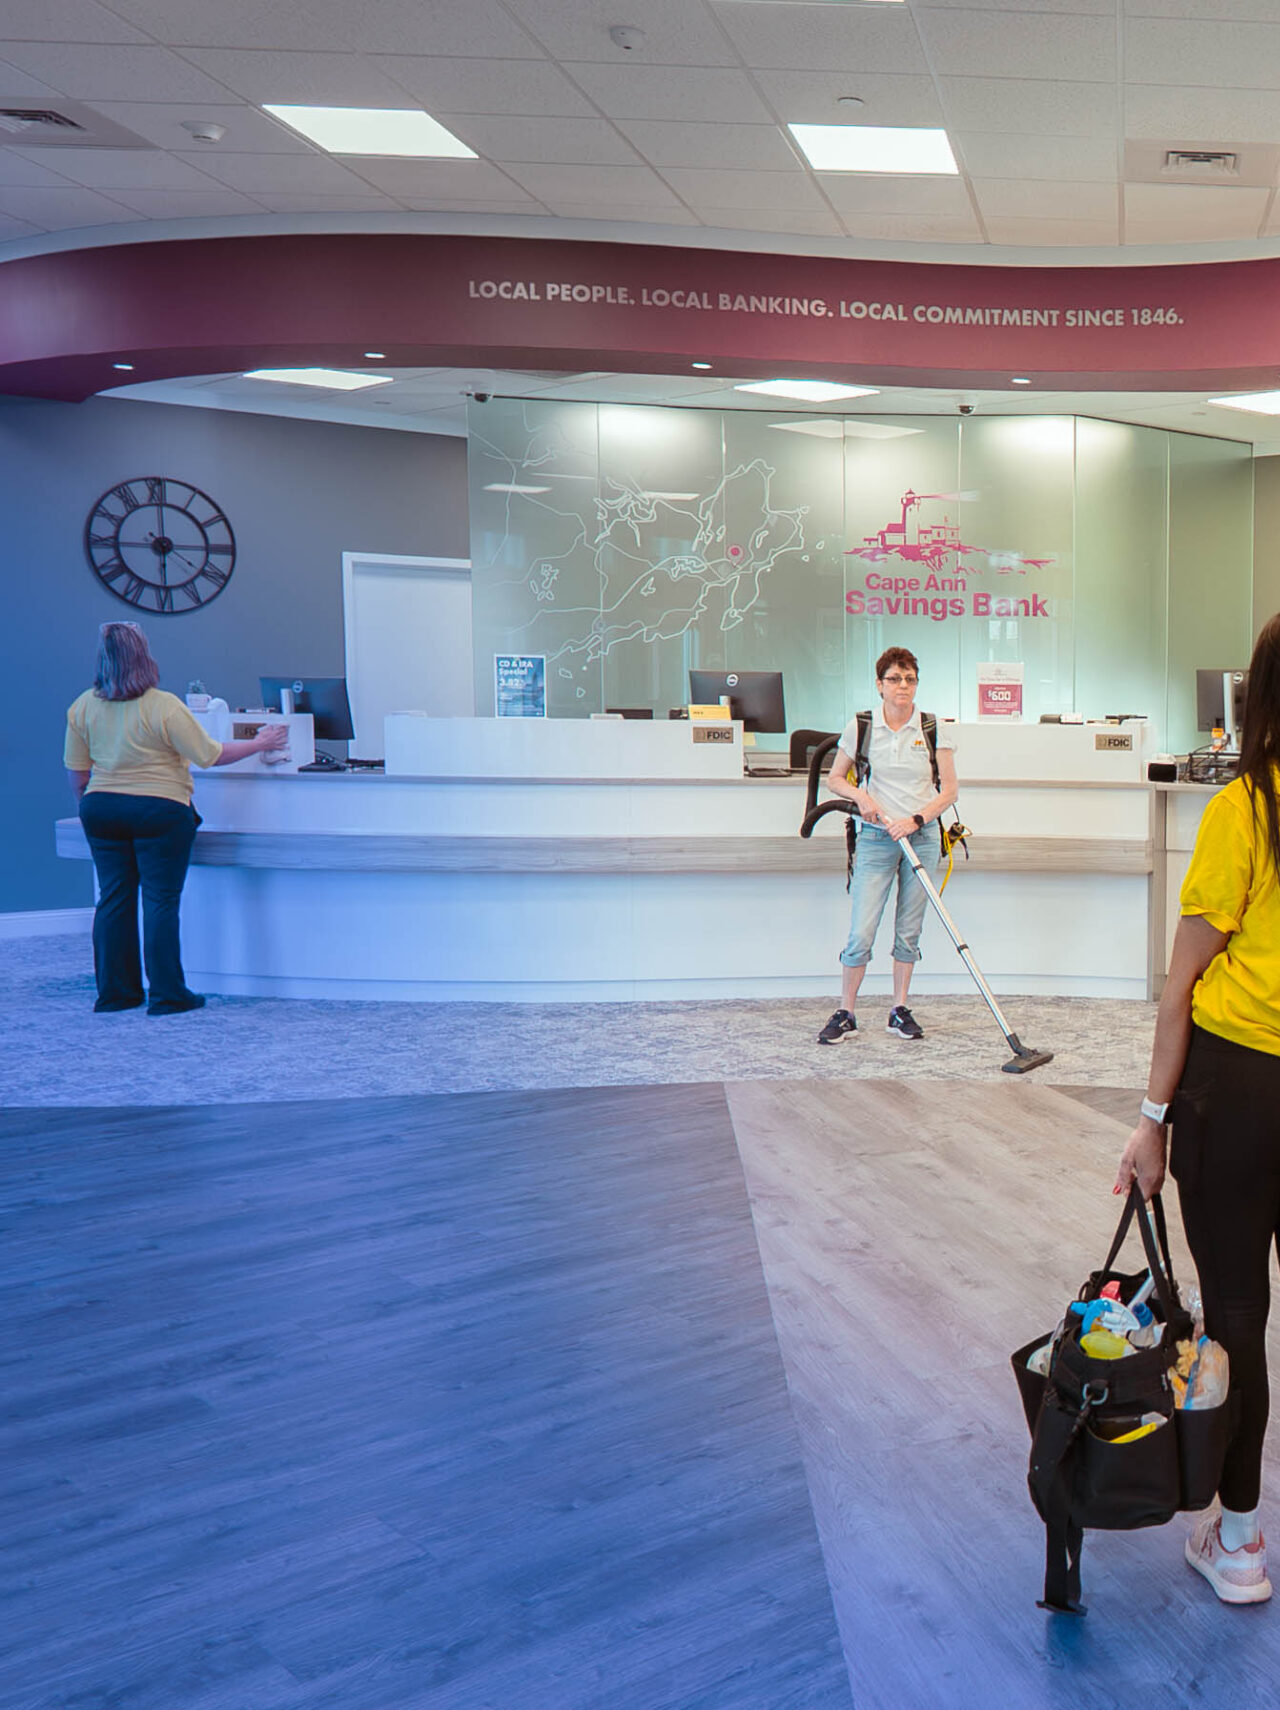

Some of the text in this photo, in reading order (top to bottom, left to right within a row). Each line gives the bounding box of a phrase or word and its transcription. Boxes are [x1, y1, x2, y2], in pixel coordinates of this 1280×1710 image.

[468, 280, 1185, 327] LOCAL PEOPLE. LOCAL BANKING. LOCAL COMMITMENT SINCE 1846.
[865, 573, 967, 594] Cape Ann
[845, 590, 1050, 622] Savings Bank
[706, 731, 731, 740] FDIC
[1107, 738, 1130, 747] FDIC
